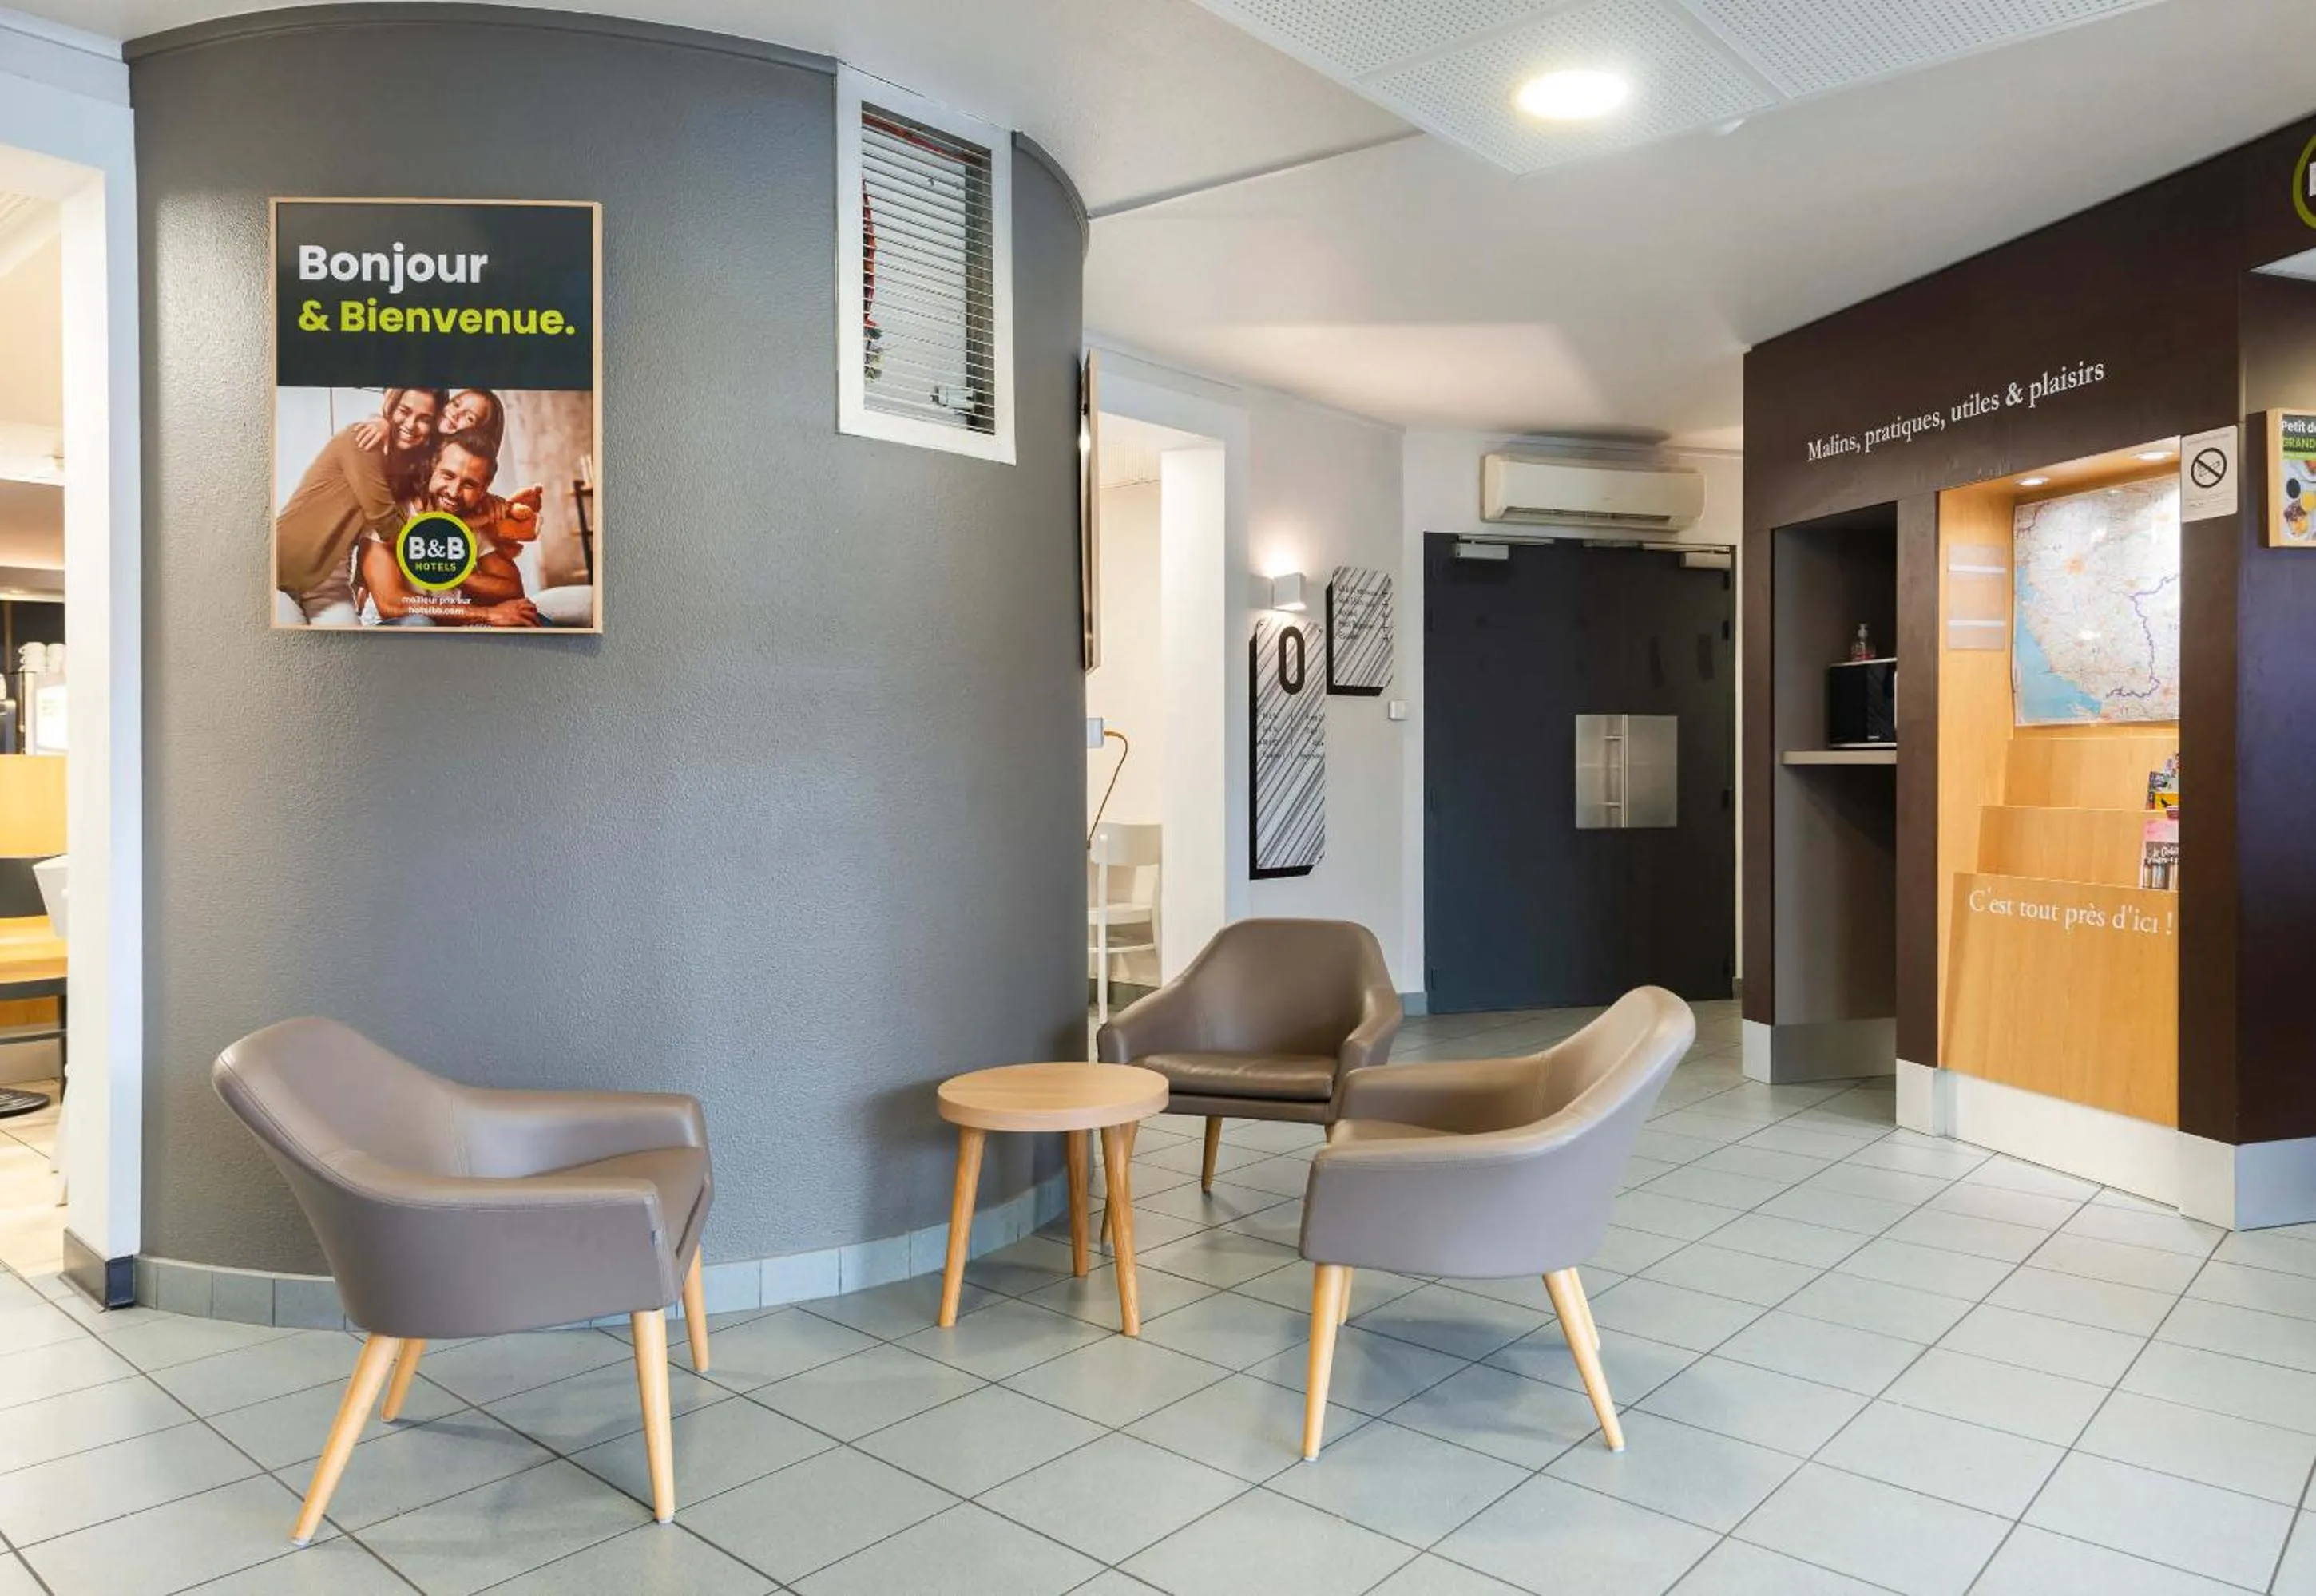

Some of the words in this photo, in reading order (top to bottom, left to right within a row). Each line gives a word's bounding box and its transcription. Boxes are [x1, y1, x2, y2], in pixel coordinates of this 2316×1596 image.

[299, 241, 488, 294] Bonjour
[298, 299, 330, 331] &
[340, 298, 576, 335] Bienvenue.
[1807, 435, 1861, 462] Malins,
[1864, 410, 1946, 453] pratiques,
[1951, 392, 1999, 423] utiles
[2005, 382, 2023, 406] &
[2028, 361, 2104, 409] plaisirs
[2282, 420, 2306, 433] Petit
[2307, 421, 2316, 433] d
[408, 536, 466, 560] B&B
[415, 562, 457, 572] HOTELS
[1279, 626, 1305, 695] 0
[1969, 887, 2013, 915] C'est
[2020, 901, 2059, 921] tout
[2065, 903, 2106, 931] près
[2112, 905, 2159, 933] d'ici
